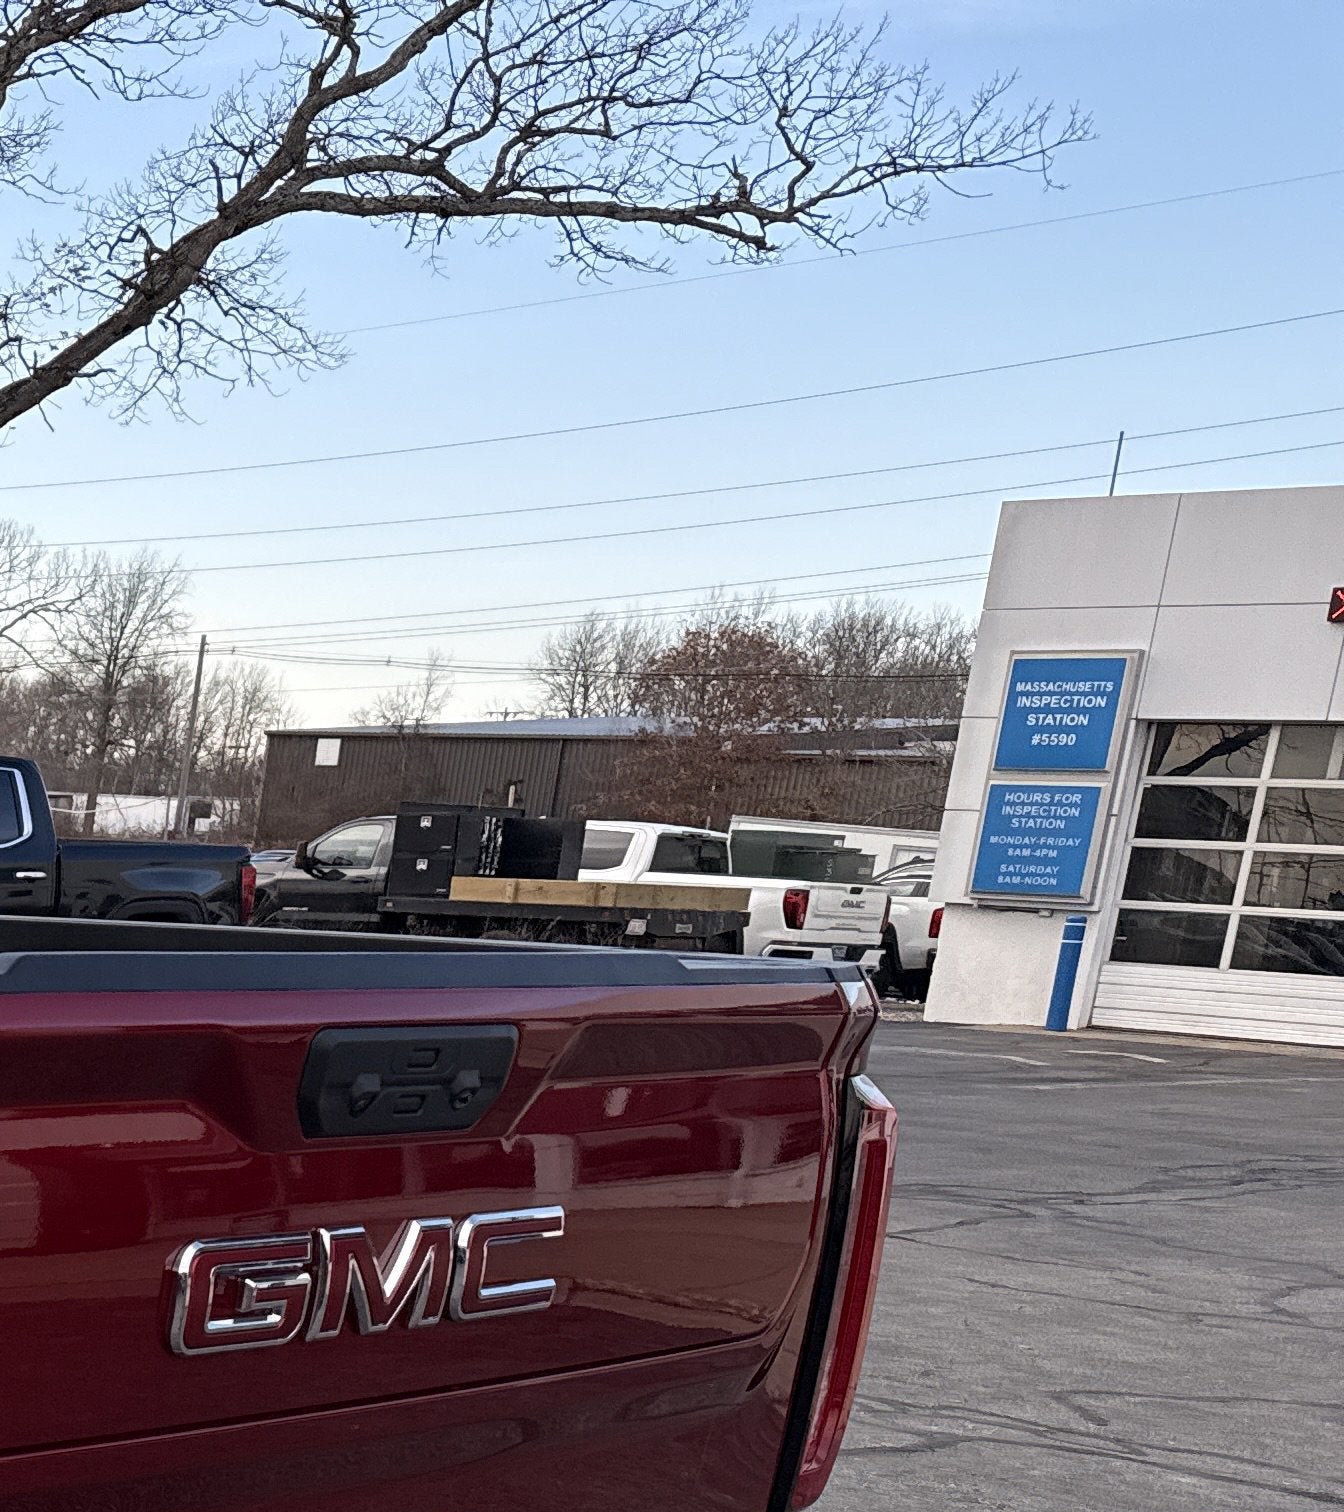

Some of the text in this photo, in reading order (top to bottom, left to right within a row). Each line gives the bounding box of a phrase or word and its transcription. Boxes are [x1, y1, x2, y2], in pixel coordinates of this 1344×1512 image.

[1015, 681, 1114, 692] MASSACHUSETTS
[1016, 695, 1107, 708] INSPECTION
[1026, 713, 1090, 726] STATION
[1031, 732, 1077, 746] #5590
[1004, 792, 1082, 804] HOURS FOR
[1001, 805, 1081, 817] INSPECTION
[1010, 818, 1066, 829] STATION
[989, 835, 1082, 846] MONDAY-FRIDAY
[1007, 847, 1058, 858] 8AM-4PM
[999, 863, 1060, 875] SATURDAY
[997, 875, 1058, 886] 8AM-NOON
[165, 1205, 565, 1356] GMC
